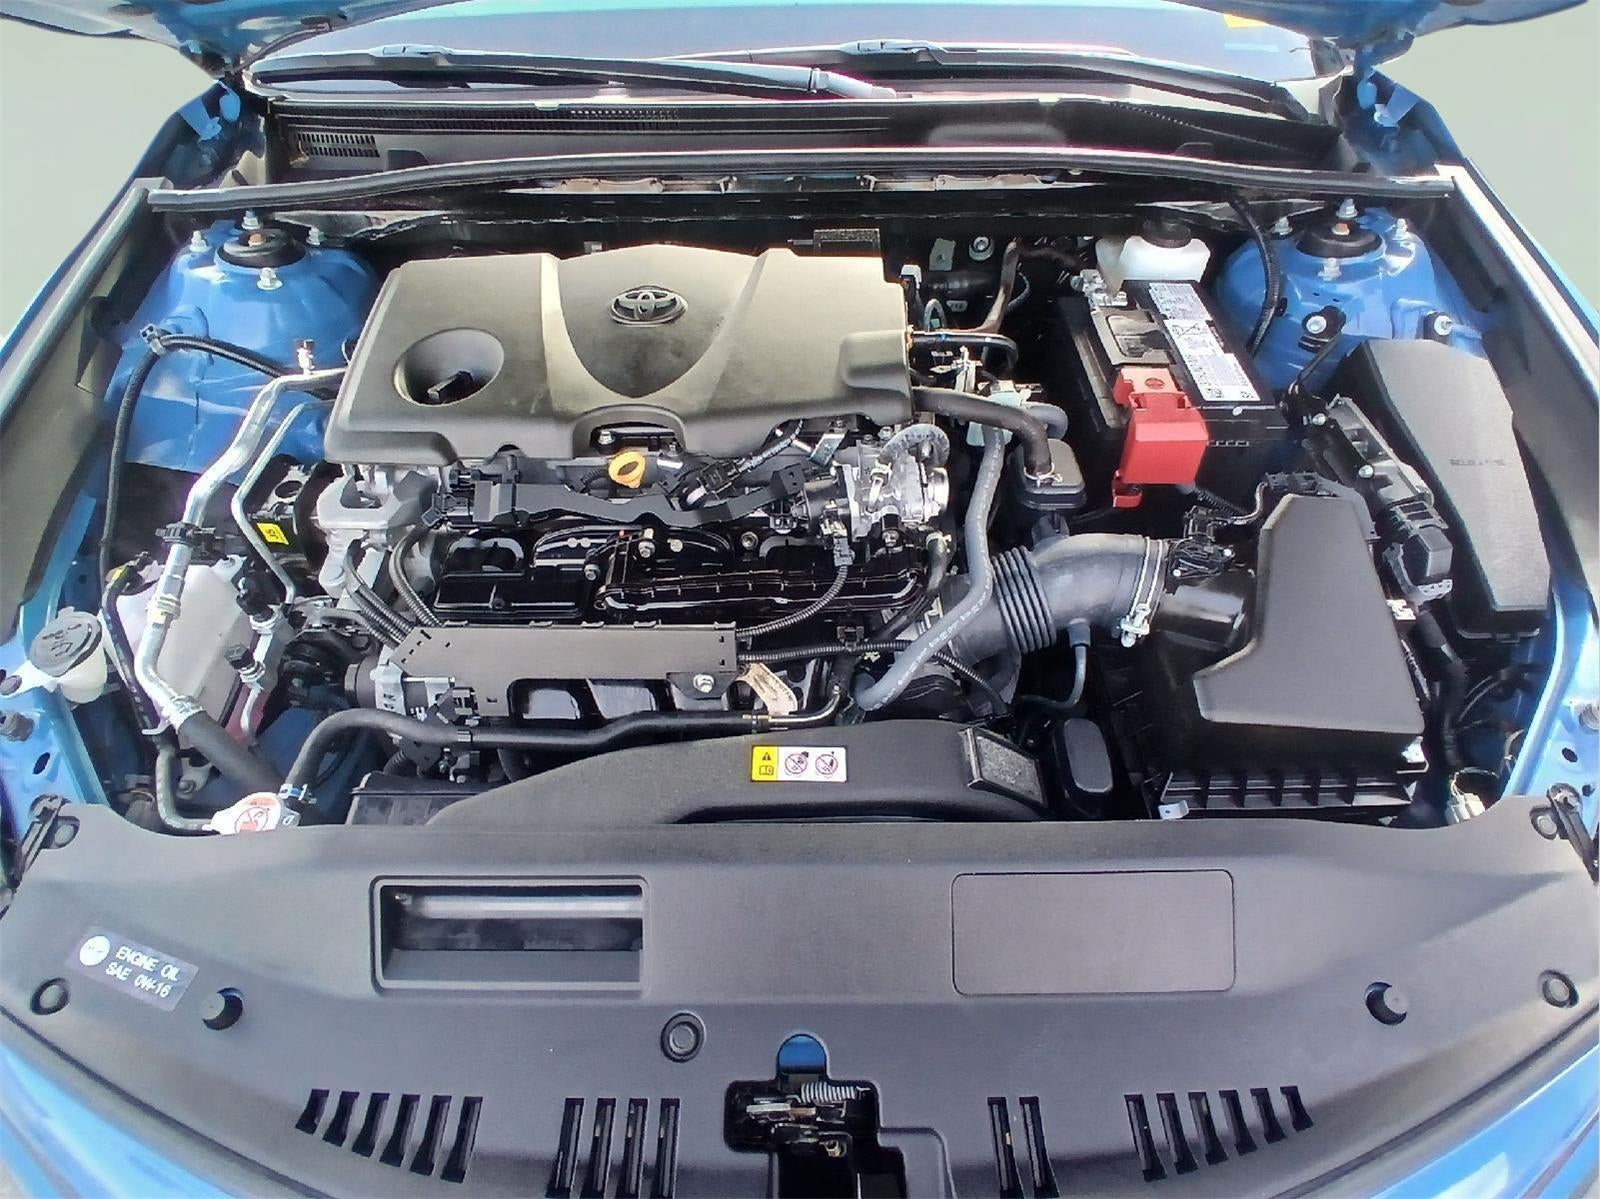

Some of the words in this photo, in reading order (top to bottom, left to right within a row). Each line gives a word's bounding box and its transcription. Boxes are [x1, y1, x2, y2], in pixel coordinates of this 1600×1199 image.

[106, 962, 132, 980] SAE
[135, 974, 171, 997] 0W-16
[116, 946, 158, 971] ENGINE
[161, 964, 180, 981] OIL
